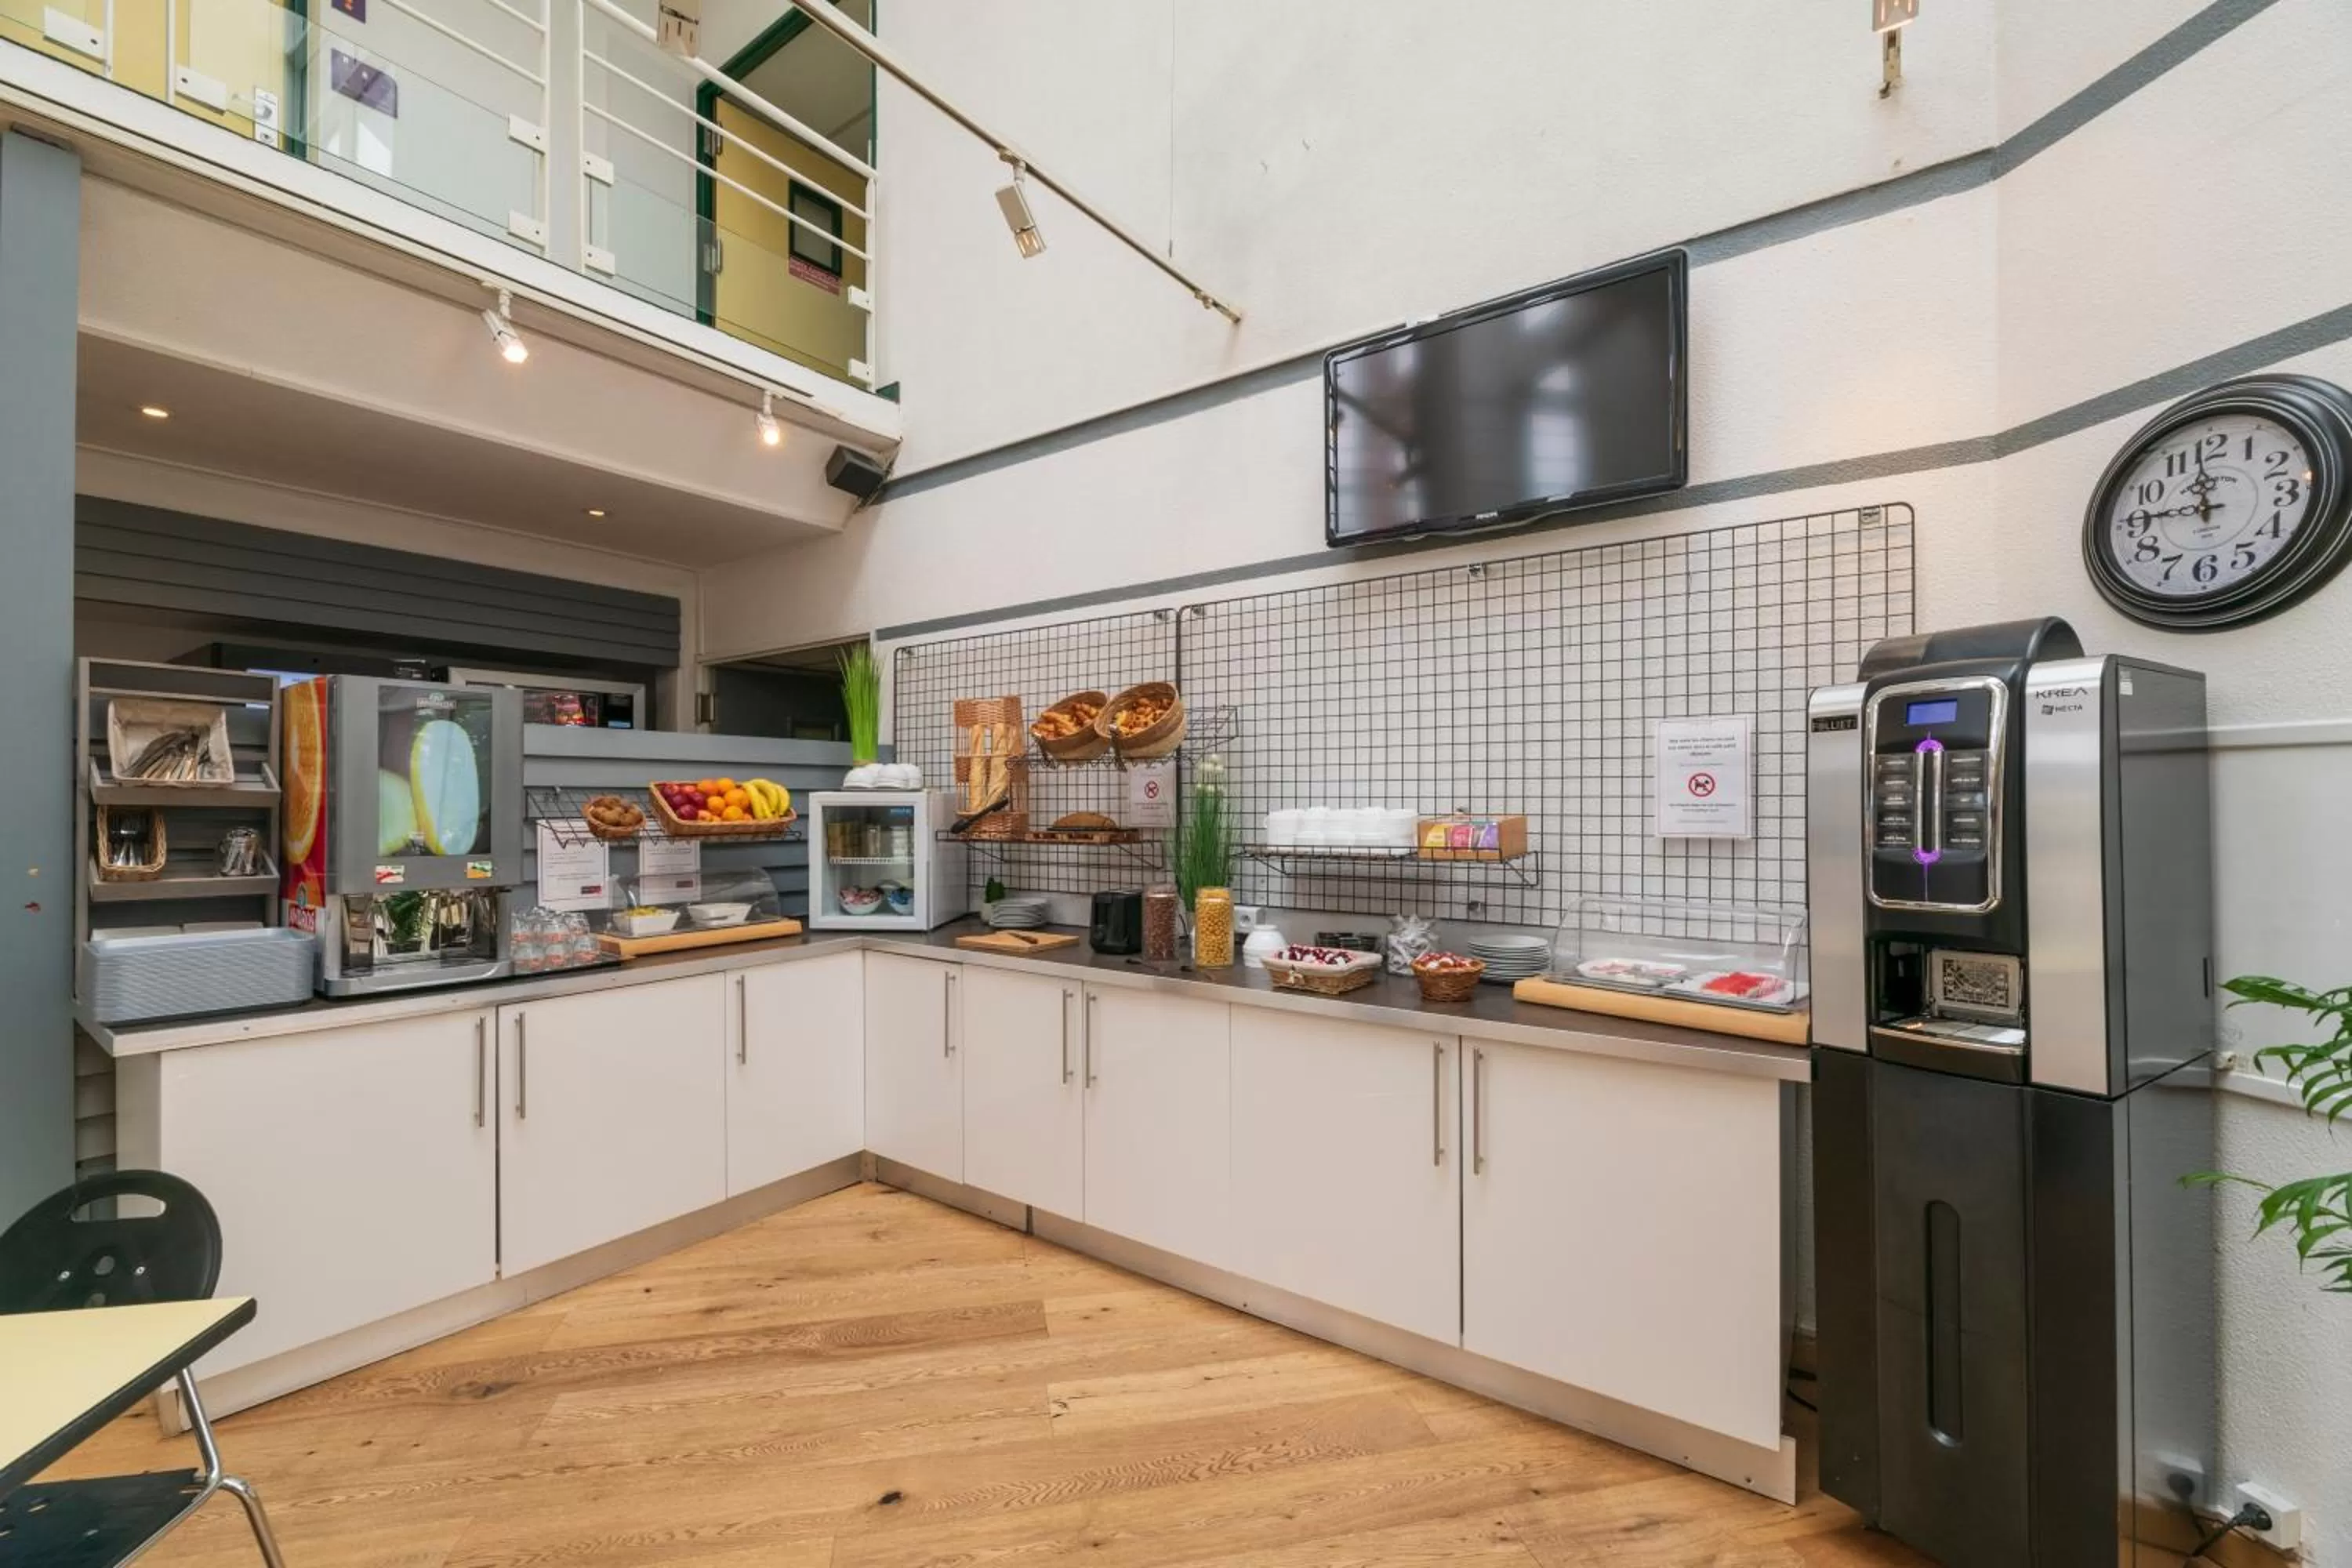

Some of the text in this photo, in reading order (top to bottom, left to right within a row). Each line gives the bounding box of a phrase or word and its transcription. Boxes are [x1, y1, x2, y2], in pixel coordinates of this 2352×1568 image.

[2195, 434, 2228, 464] 12
[2244, 435, 2252, 460] 1
[2166, 451, 2187, 477] 11
[2263, 451, 2290, 481] 2
[2138, 479, 2165, 505] 10
[2273, 478, 2299, 507] 3
[2127, 509, 2152, 539] 9
[2255, 510, 2281, 539] 4
[2133, 535, 2161, 563] 8
[2230, 541, 2256, 570] 5
[2161, 553, 2183, 581] 7
[2191, 554, 2219, 583] 6
